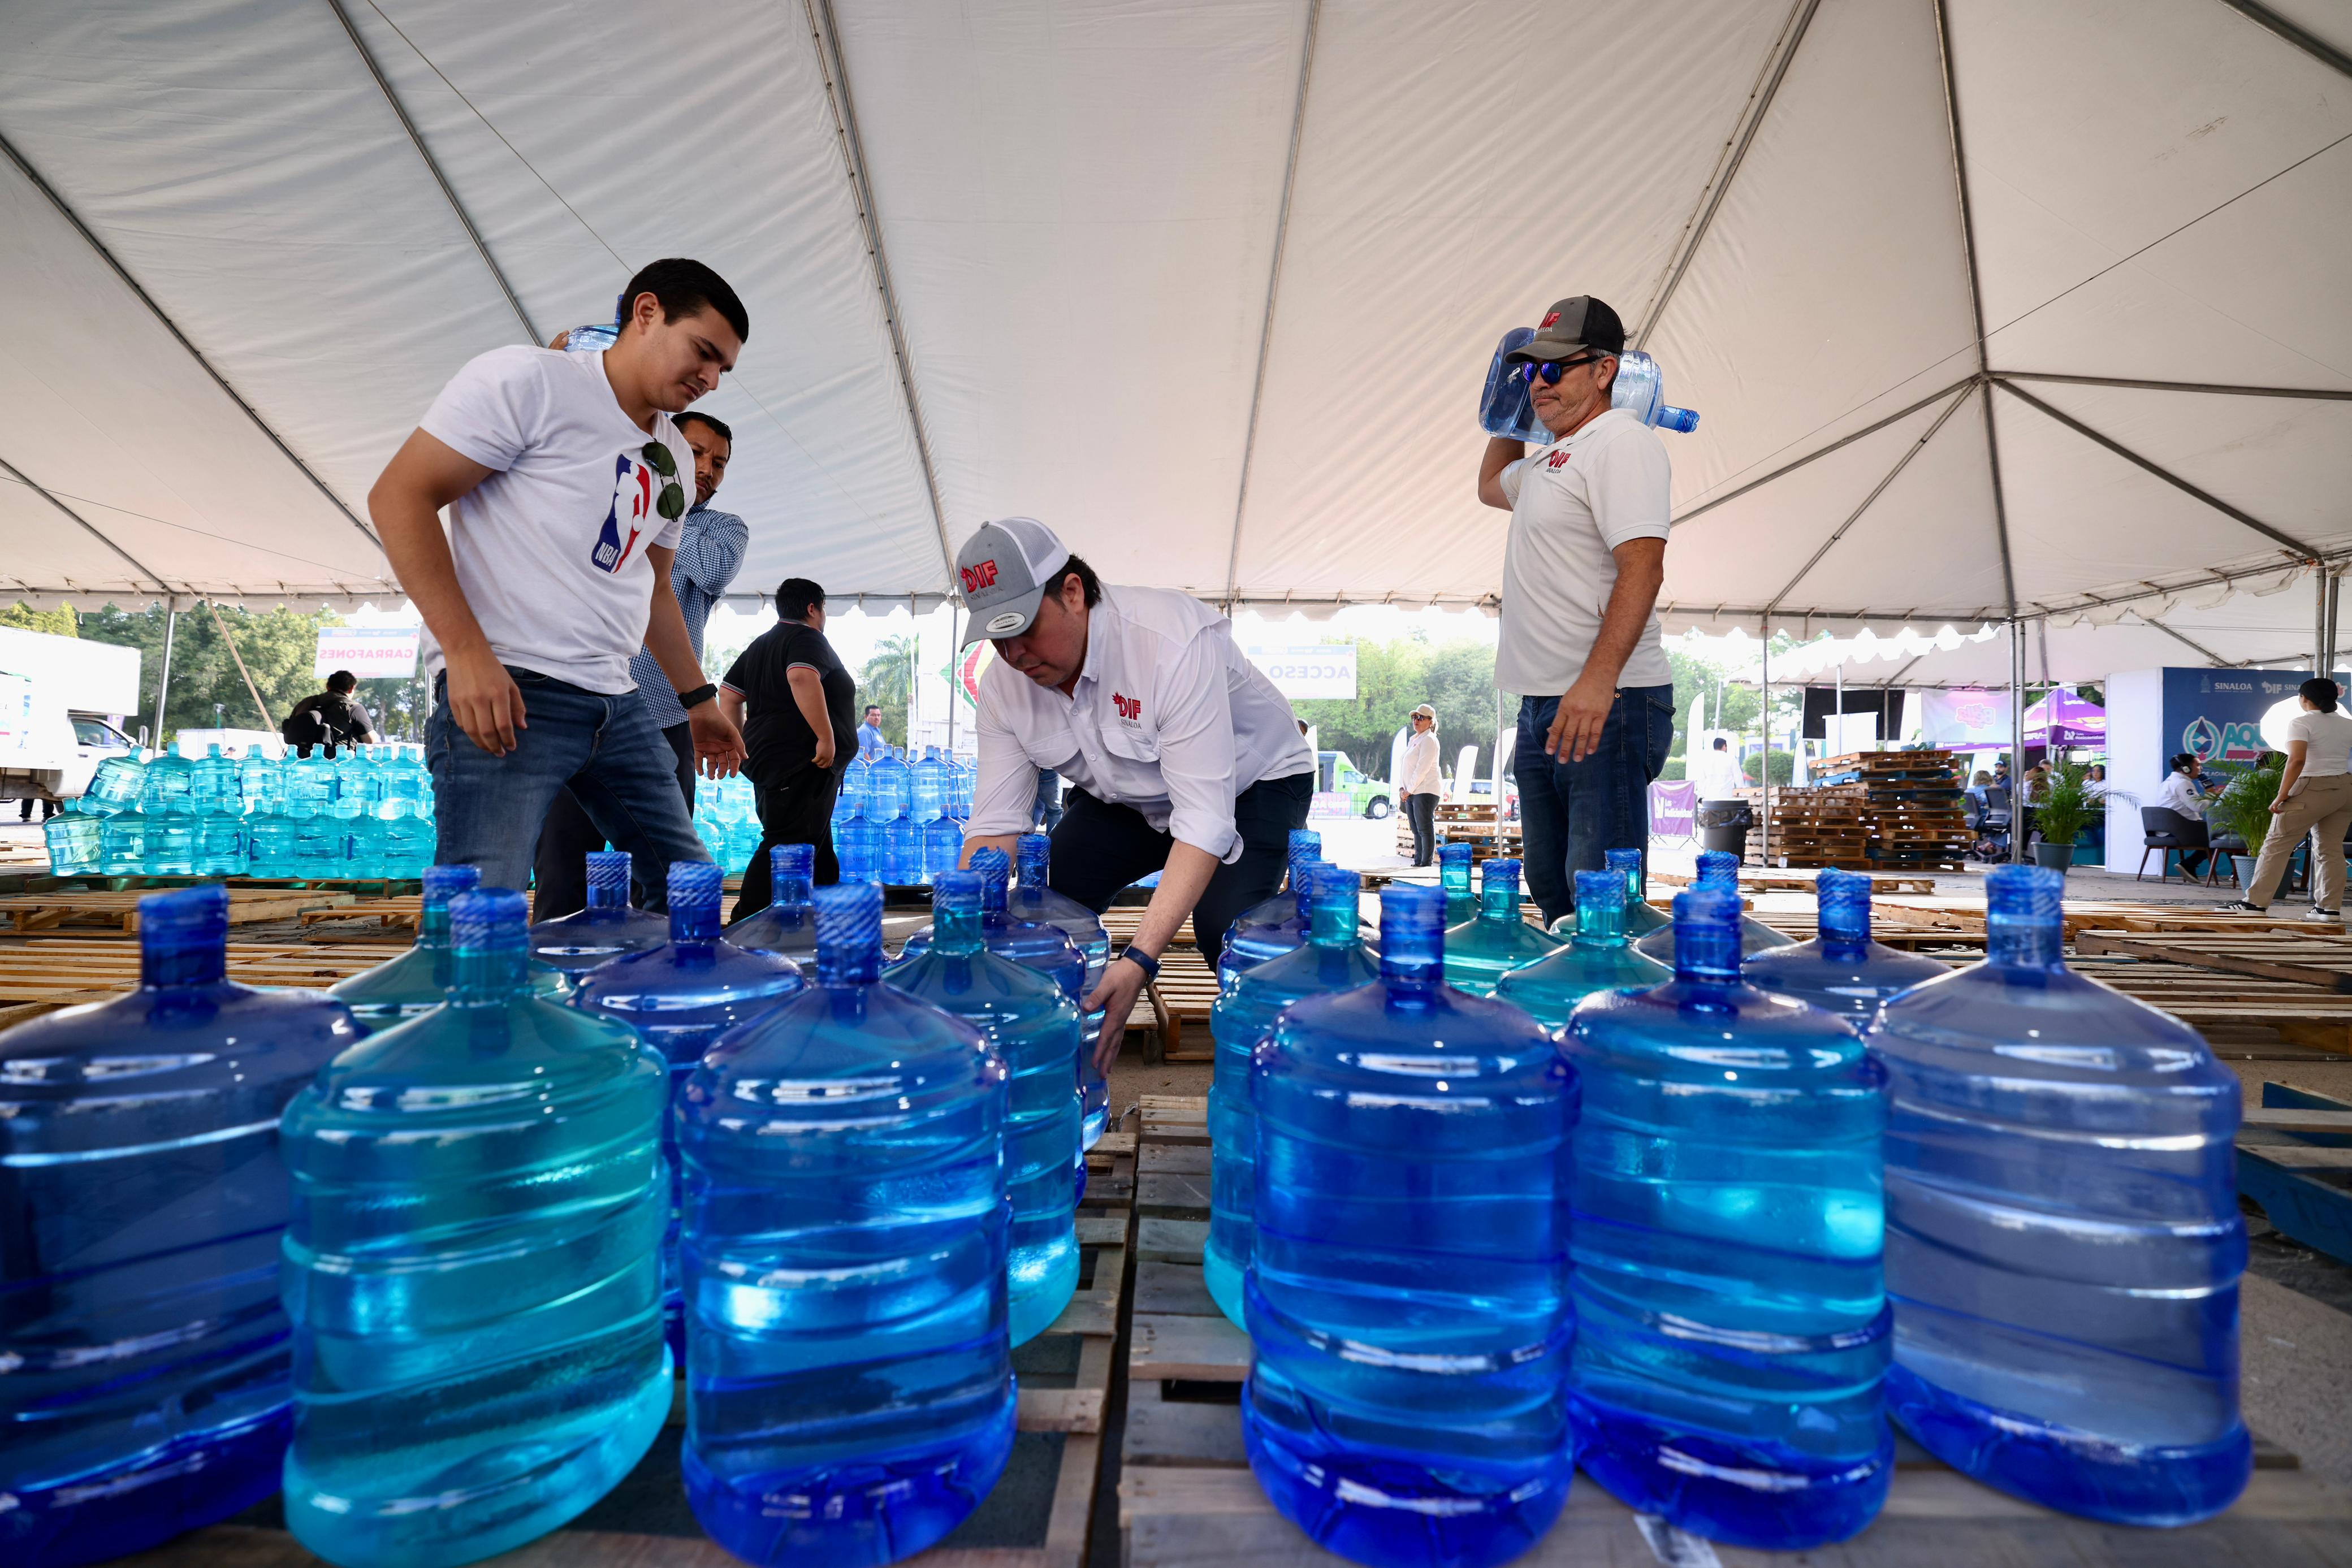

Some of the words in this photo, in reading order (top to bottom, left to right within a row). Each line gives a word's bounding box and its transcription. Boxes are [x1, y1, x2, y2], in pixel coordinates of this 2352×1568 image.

[1538, 311, 1561, 331] IF
[1549, 451, 1571, 468] DIF
[595, 542, 619, 566] NBA
[962, 559, 998, 594] DIF
[2265, 683, 2282, 694] DIF
[1119, 695, 1141, 721] DIF
[1121, 718, 1142, 729] SINALOA
[2219, 723, 2268, 759] AQU
